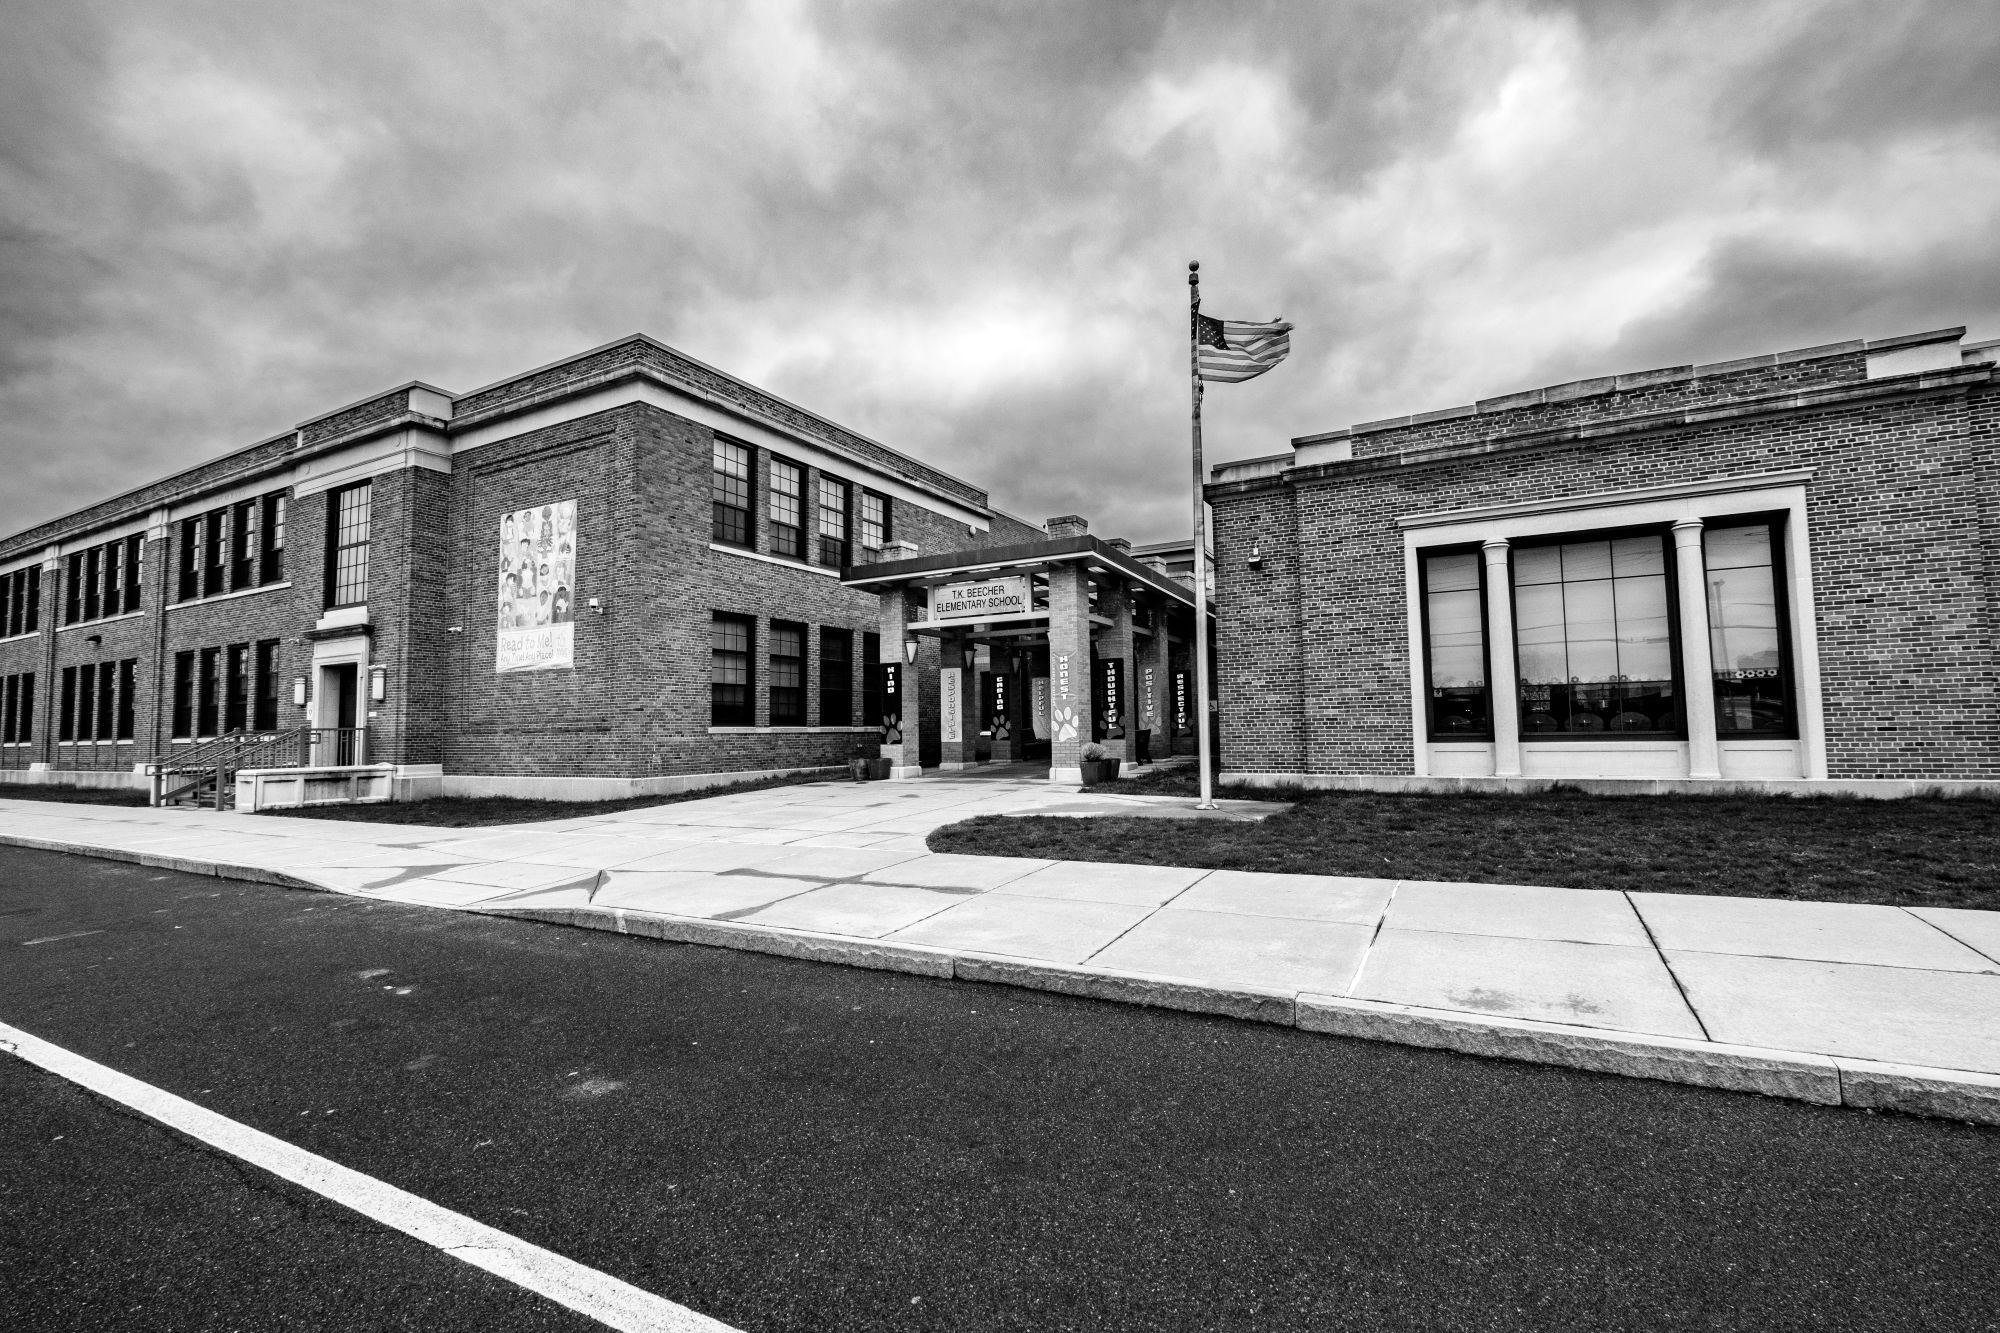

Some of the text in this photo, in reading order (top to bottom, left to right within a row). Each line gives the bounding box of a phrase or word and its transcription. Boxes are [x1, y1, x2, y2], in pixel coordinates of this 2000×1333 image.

[936, 595, 1022, 613] ELEMENTARY SCHOOL
[952, 585, 1005, 599] T.K. BEECHER
[501, 636, 523, 652] Read
[525, 635, 535, 650] to
[887, 666, 895, 694] KIND
[996, 676, 1004, 710] CARING
[1059, 655, 1069, 700] HONEST
[1145, 668, 1154, 718] POSITIVE
[1107, 662, 1117, 730] THOUGHTFUL
[1176, 673, 1186, 729] RESPECTFUL
